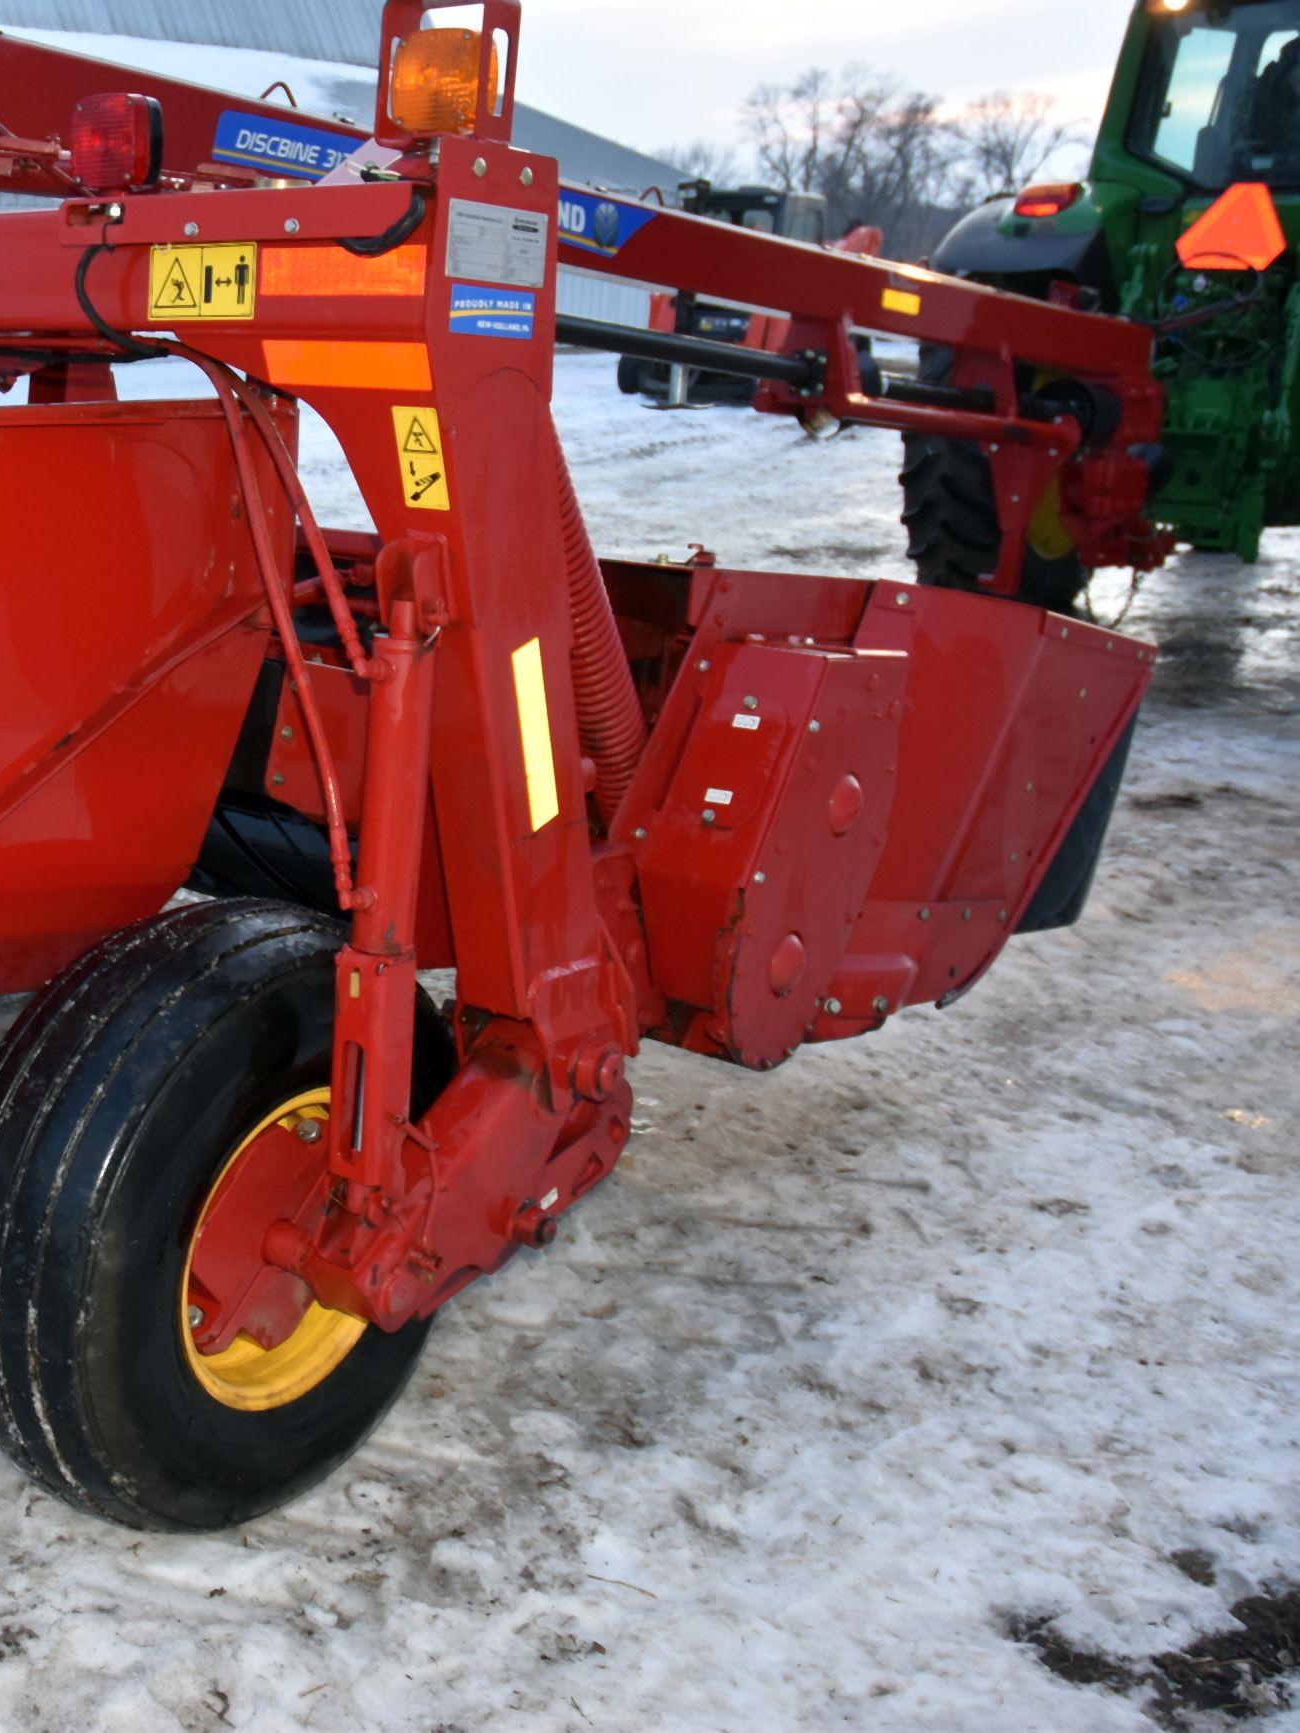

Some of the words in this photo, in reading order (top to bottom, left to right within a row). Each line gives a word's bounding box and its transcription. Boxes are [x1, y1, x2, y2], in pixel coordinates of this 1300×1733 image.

[236, 129, 321, 165] DISCBINE
[322, 149, 350, 168] 31
[454, 299, 494, 309] PROUDLY
[496, 300, 519, 310] MADE
